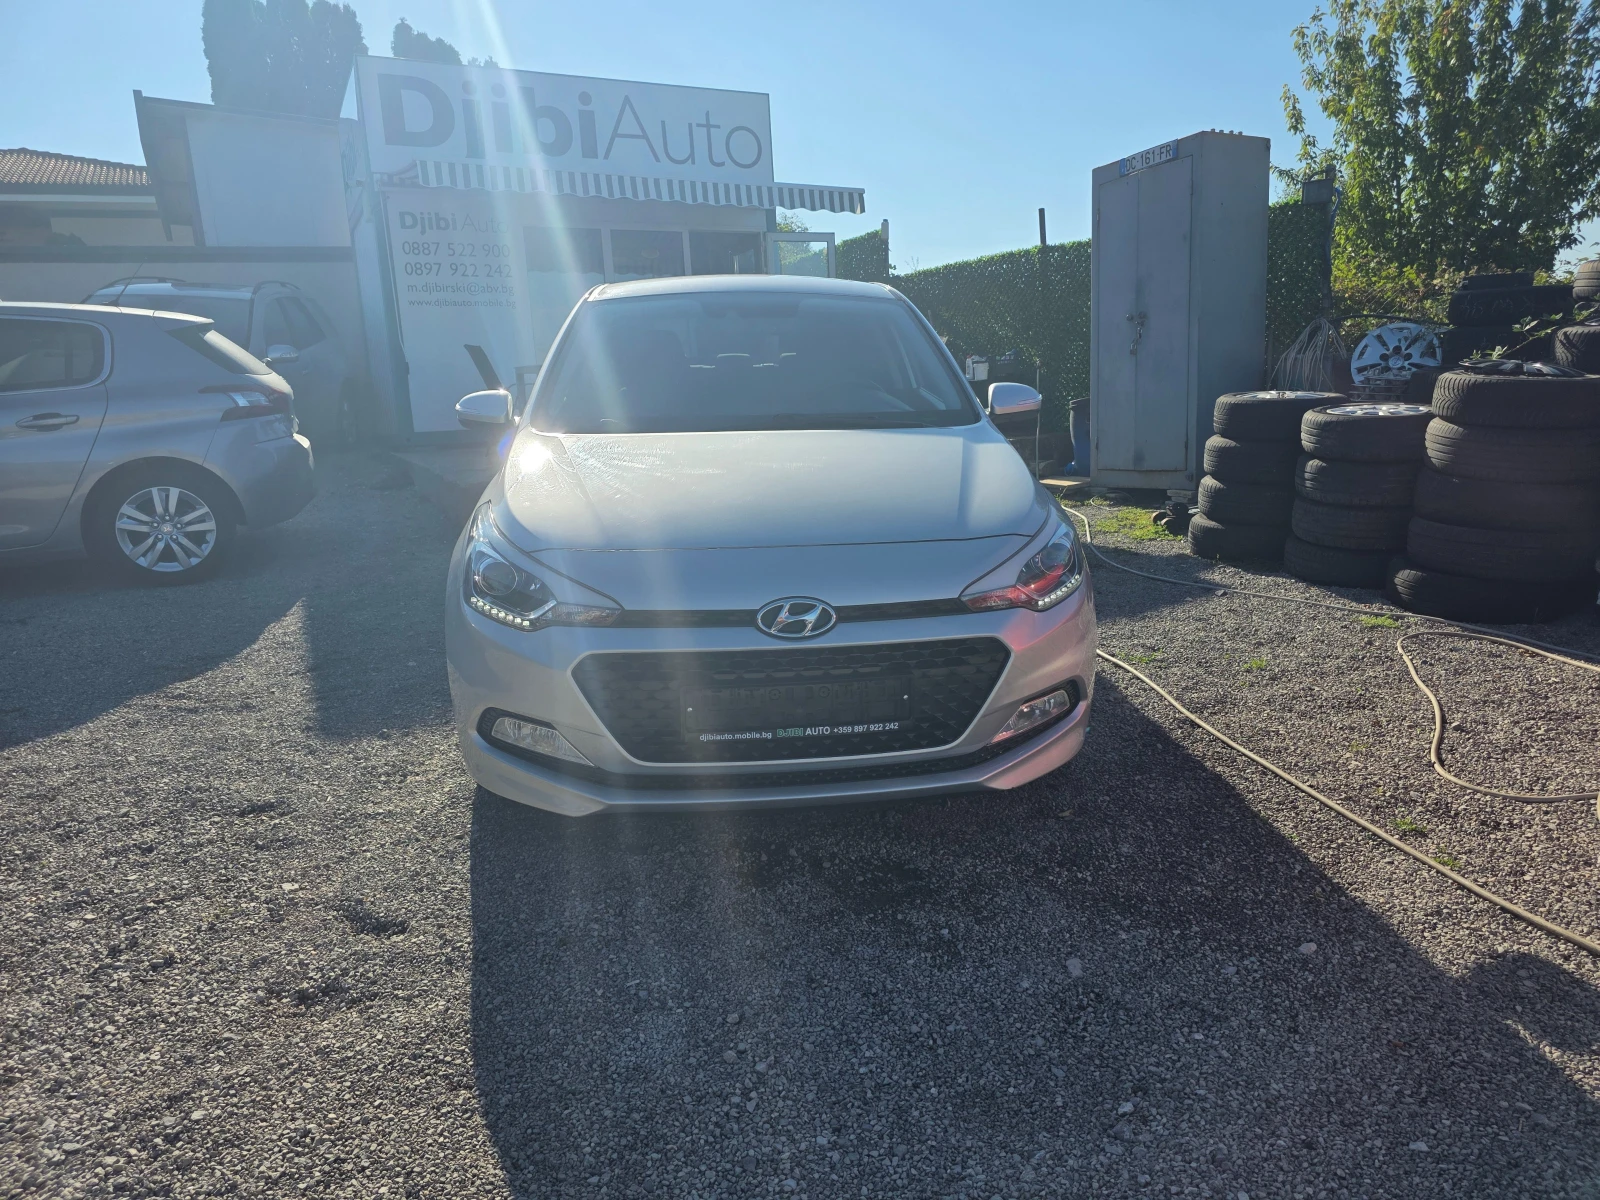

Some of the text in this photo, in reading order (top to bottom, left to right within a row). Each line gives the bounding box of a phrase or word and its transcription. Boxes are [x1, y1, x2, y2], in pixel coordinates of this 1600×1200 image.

[402, 241, 511, 258] 0887 522 900
[404, 262, 513, 278] 0897 922 242
[407, 281, 515, 296] m.djibirski@abv.bg
[408, 298, 516, 309] www.djibiauto.mobile.bg
[699, 721, 899, 742] djibiauto.mobile.bg DJIBI AUTO +359 897 922 242
